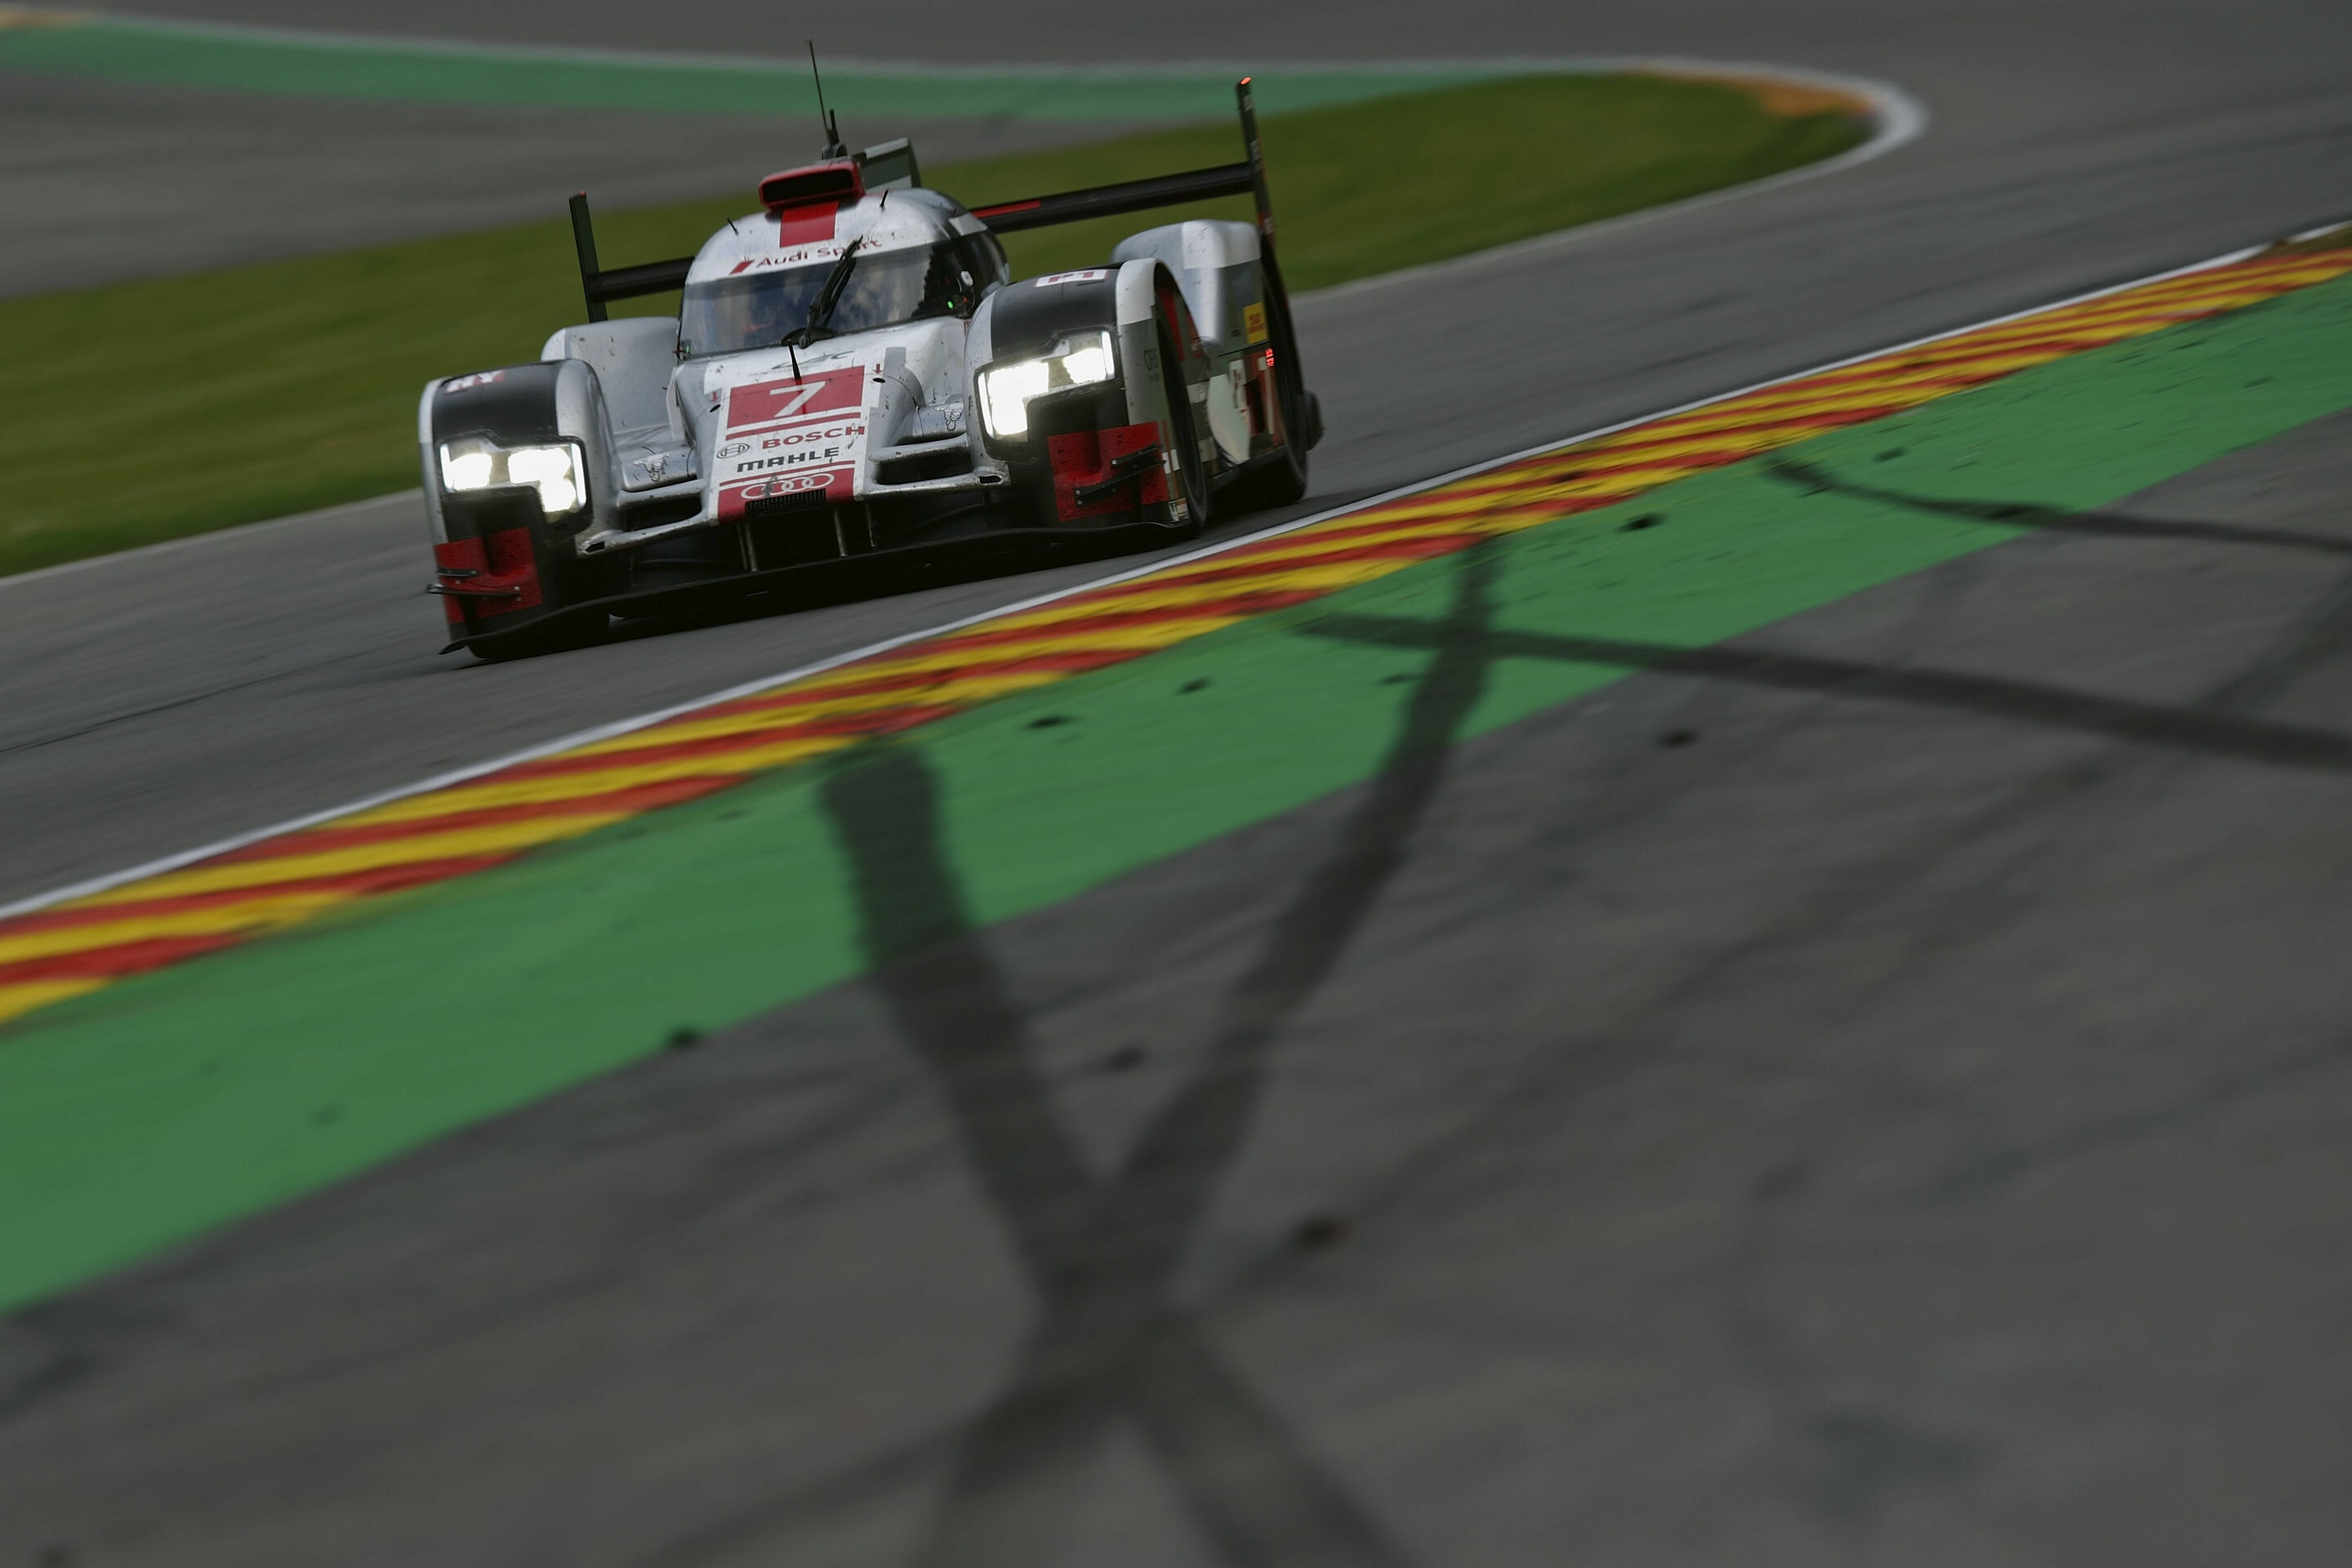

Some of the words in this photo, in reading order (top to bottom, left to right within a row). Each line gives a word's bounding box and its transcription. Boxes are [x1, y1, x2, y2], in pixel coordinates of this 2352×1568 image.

[756, 251, 808, 268] Audi
[817, 239, 882, 257] Sprt
[769, 381, 826, 418] 7
[762, 425, 865, 449] BOSCH
[737, 447, 840, 473] MAHLE
